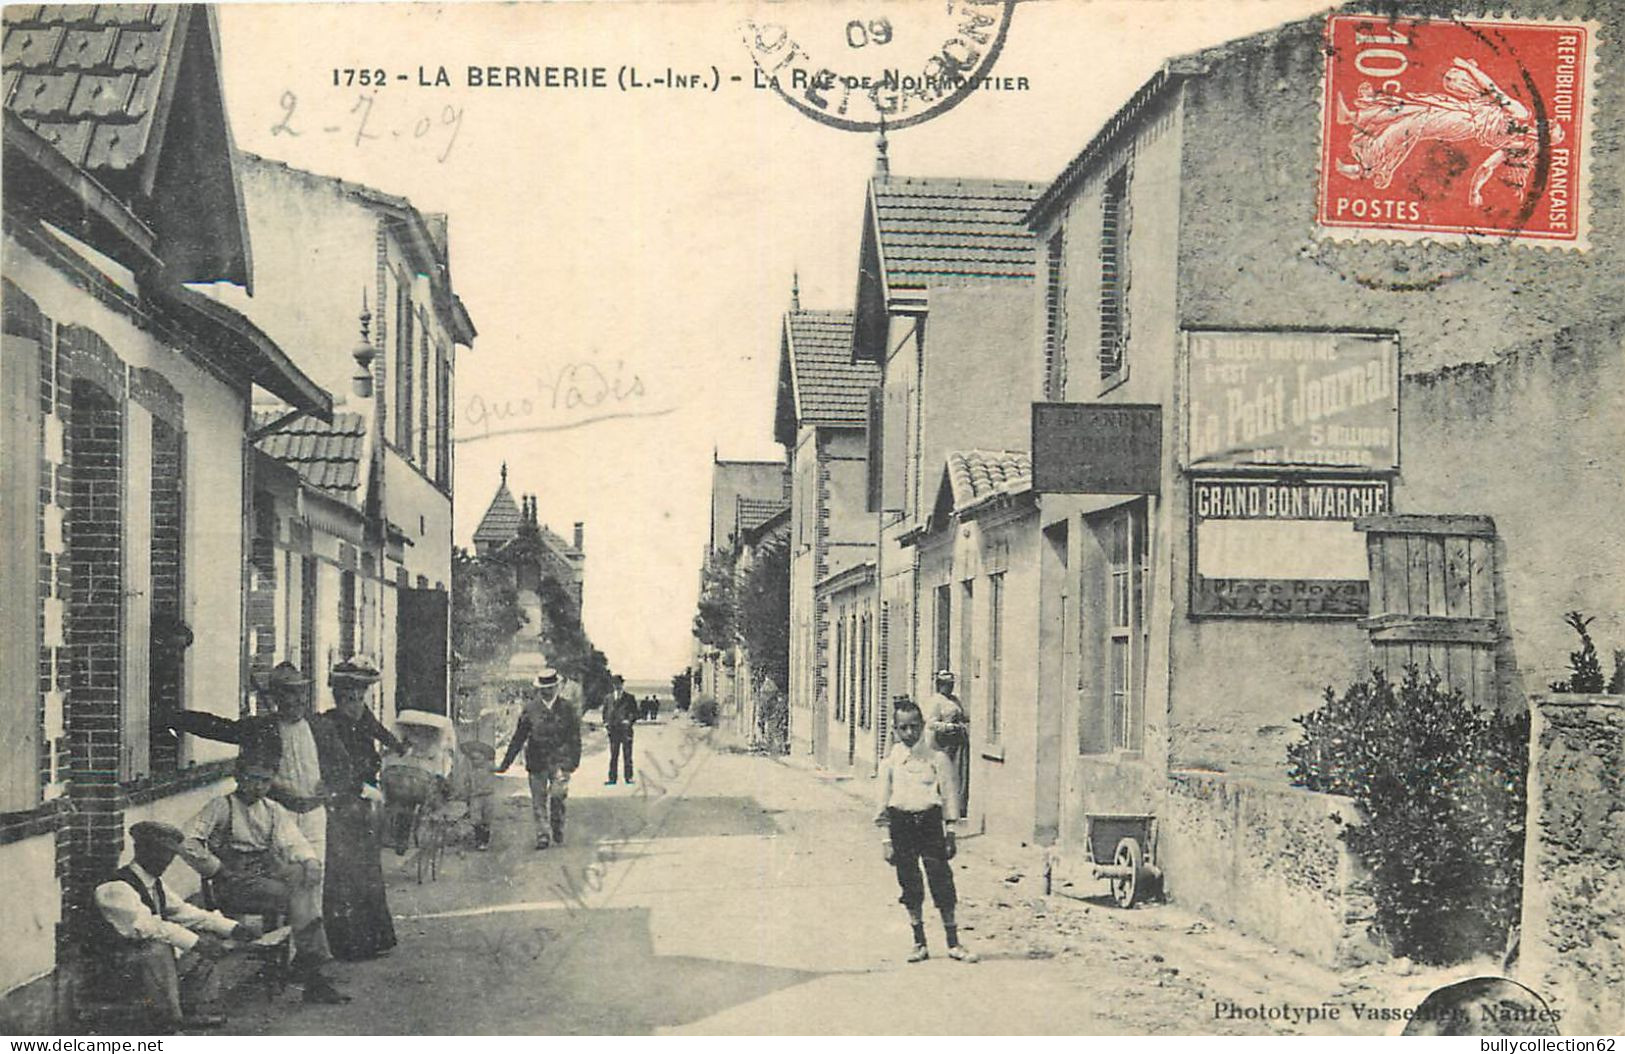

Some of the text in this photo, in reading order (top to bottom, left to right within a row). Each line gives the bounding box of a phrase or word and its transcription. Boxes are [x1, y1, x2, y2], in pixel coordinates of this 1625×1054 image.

[846, 19, 892, 48] 09
[333, 68, 387, 87] 1752
[419, 66, 451, 87] LA
[468, 66, 608, 88] BERNERIE
[1336, 198, 1421, 220] POSTES
[1190, 340, 1392, 460] Le Petit Journal
[1310, 423, 1326, 446] 5
[1198, 486, 1259, 517] GRAND
[1265, 486, 1302, 518] BON
[1216, 597, 1364, 613] NANTES
[1214, 1001, 1340, 1024] Phototypie
[1481, 1004, 1562, 1022] Nantes
